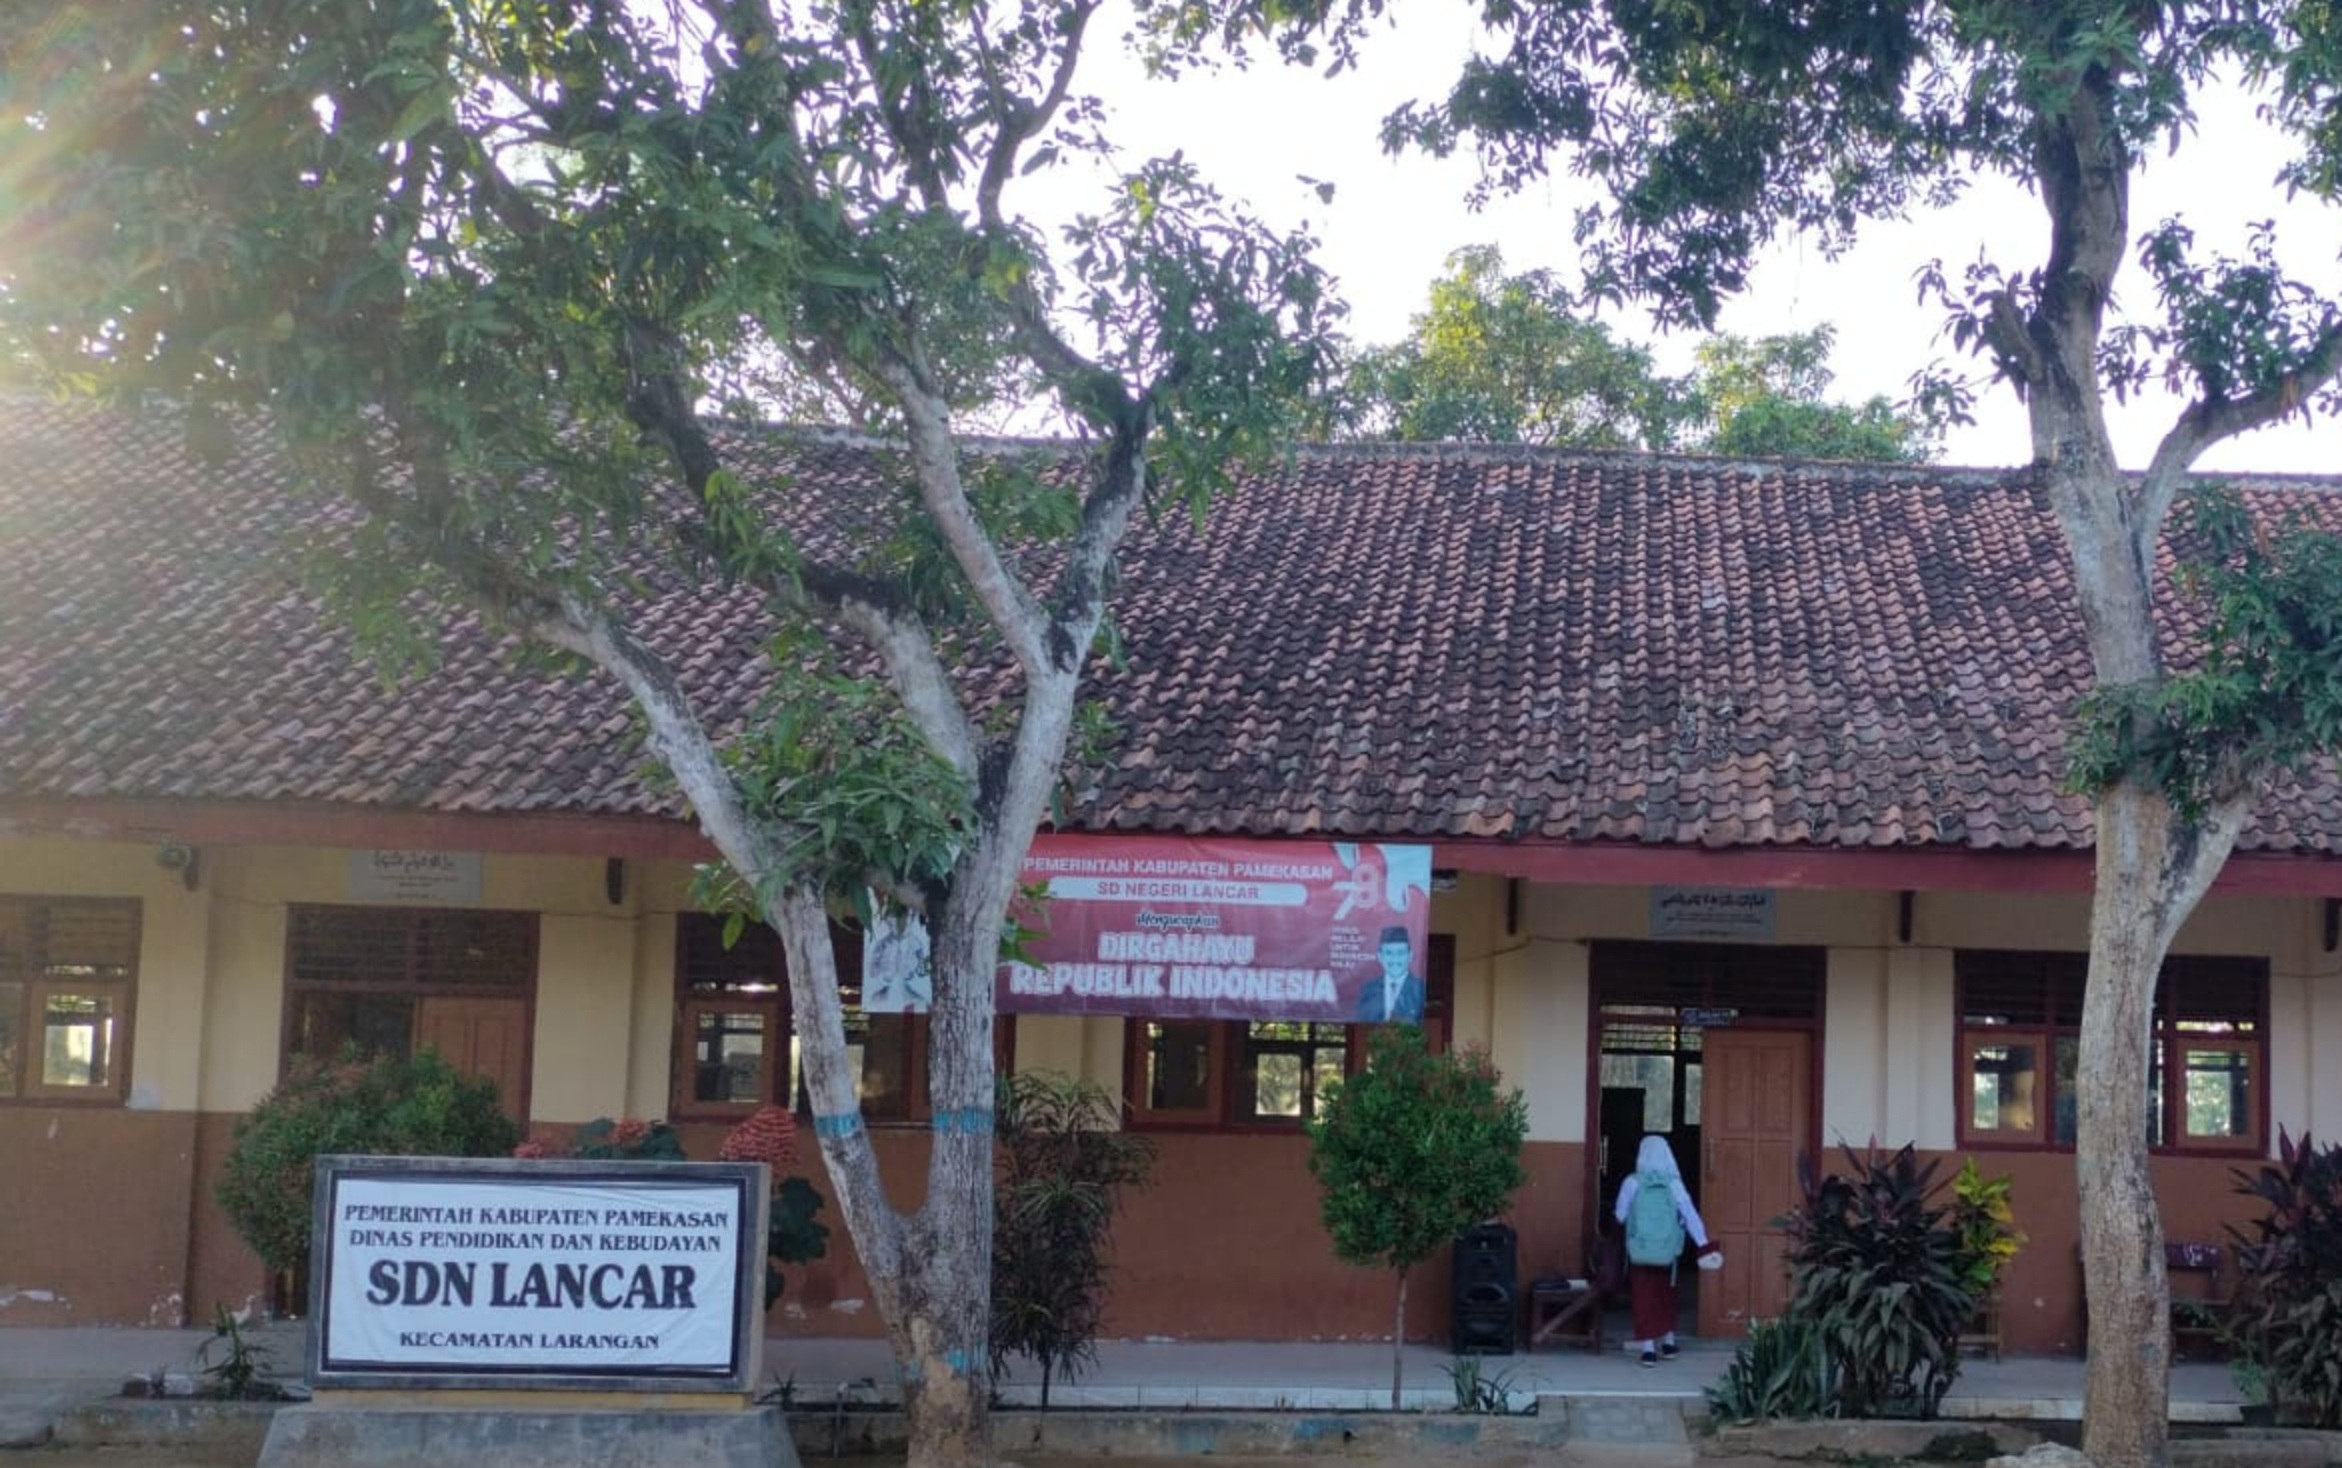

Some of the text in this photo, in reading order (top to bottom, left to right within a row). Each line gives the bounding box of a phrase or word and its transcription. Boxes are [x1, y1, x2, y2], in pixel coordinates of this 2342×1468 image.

[1023, 857, 1333, 879] PEMERINTAH KABUPATEN PAMEKASAN
[1097, 881, 1260, 900] SD NEGERI LANCAR
[1098, 931, 1255, 964] DIRGAHAYU
[1010, 960, 1338, 1002] REPUBLIK INDONESIA
[345, 1205, 729, 1229] PEMERINTAH KABUPATEN PAMEKASAN
[350, 1229, 721, 1252] DINAS PENDIDIKAN DAN KEBUDAYAN
[366, 1259, 698, 1310] SDN LANCAR
[400, 1331, 660, 1350] KECAMATAN LARANGAN
